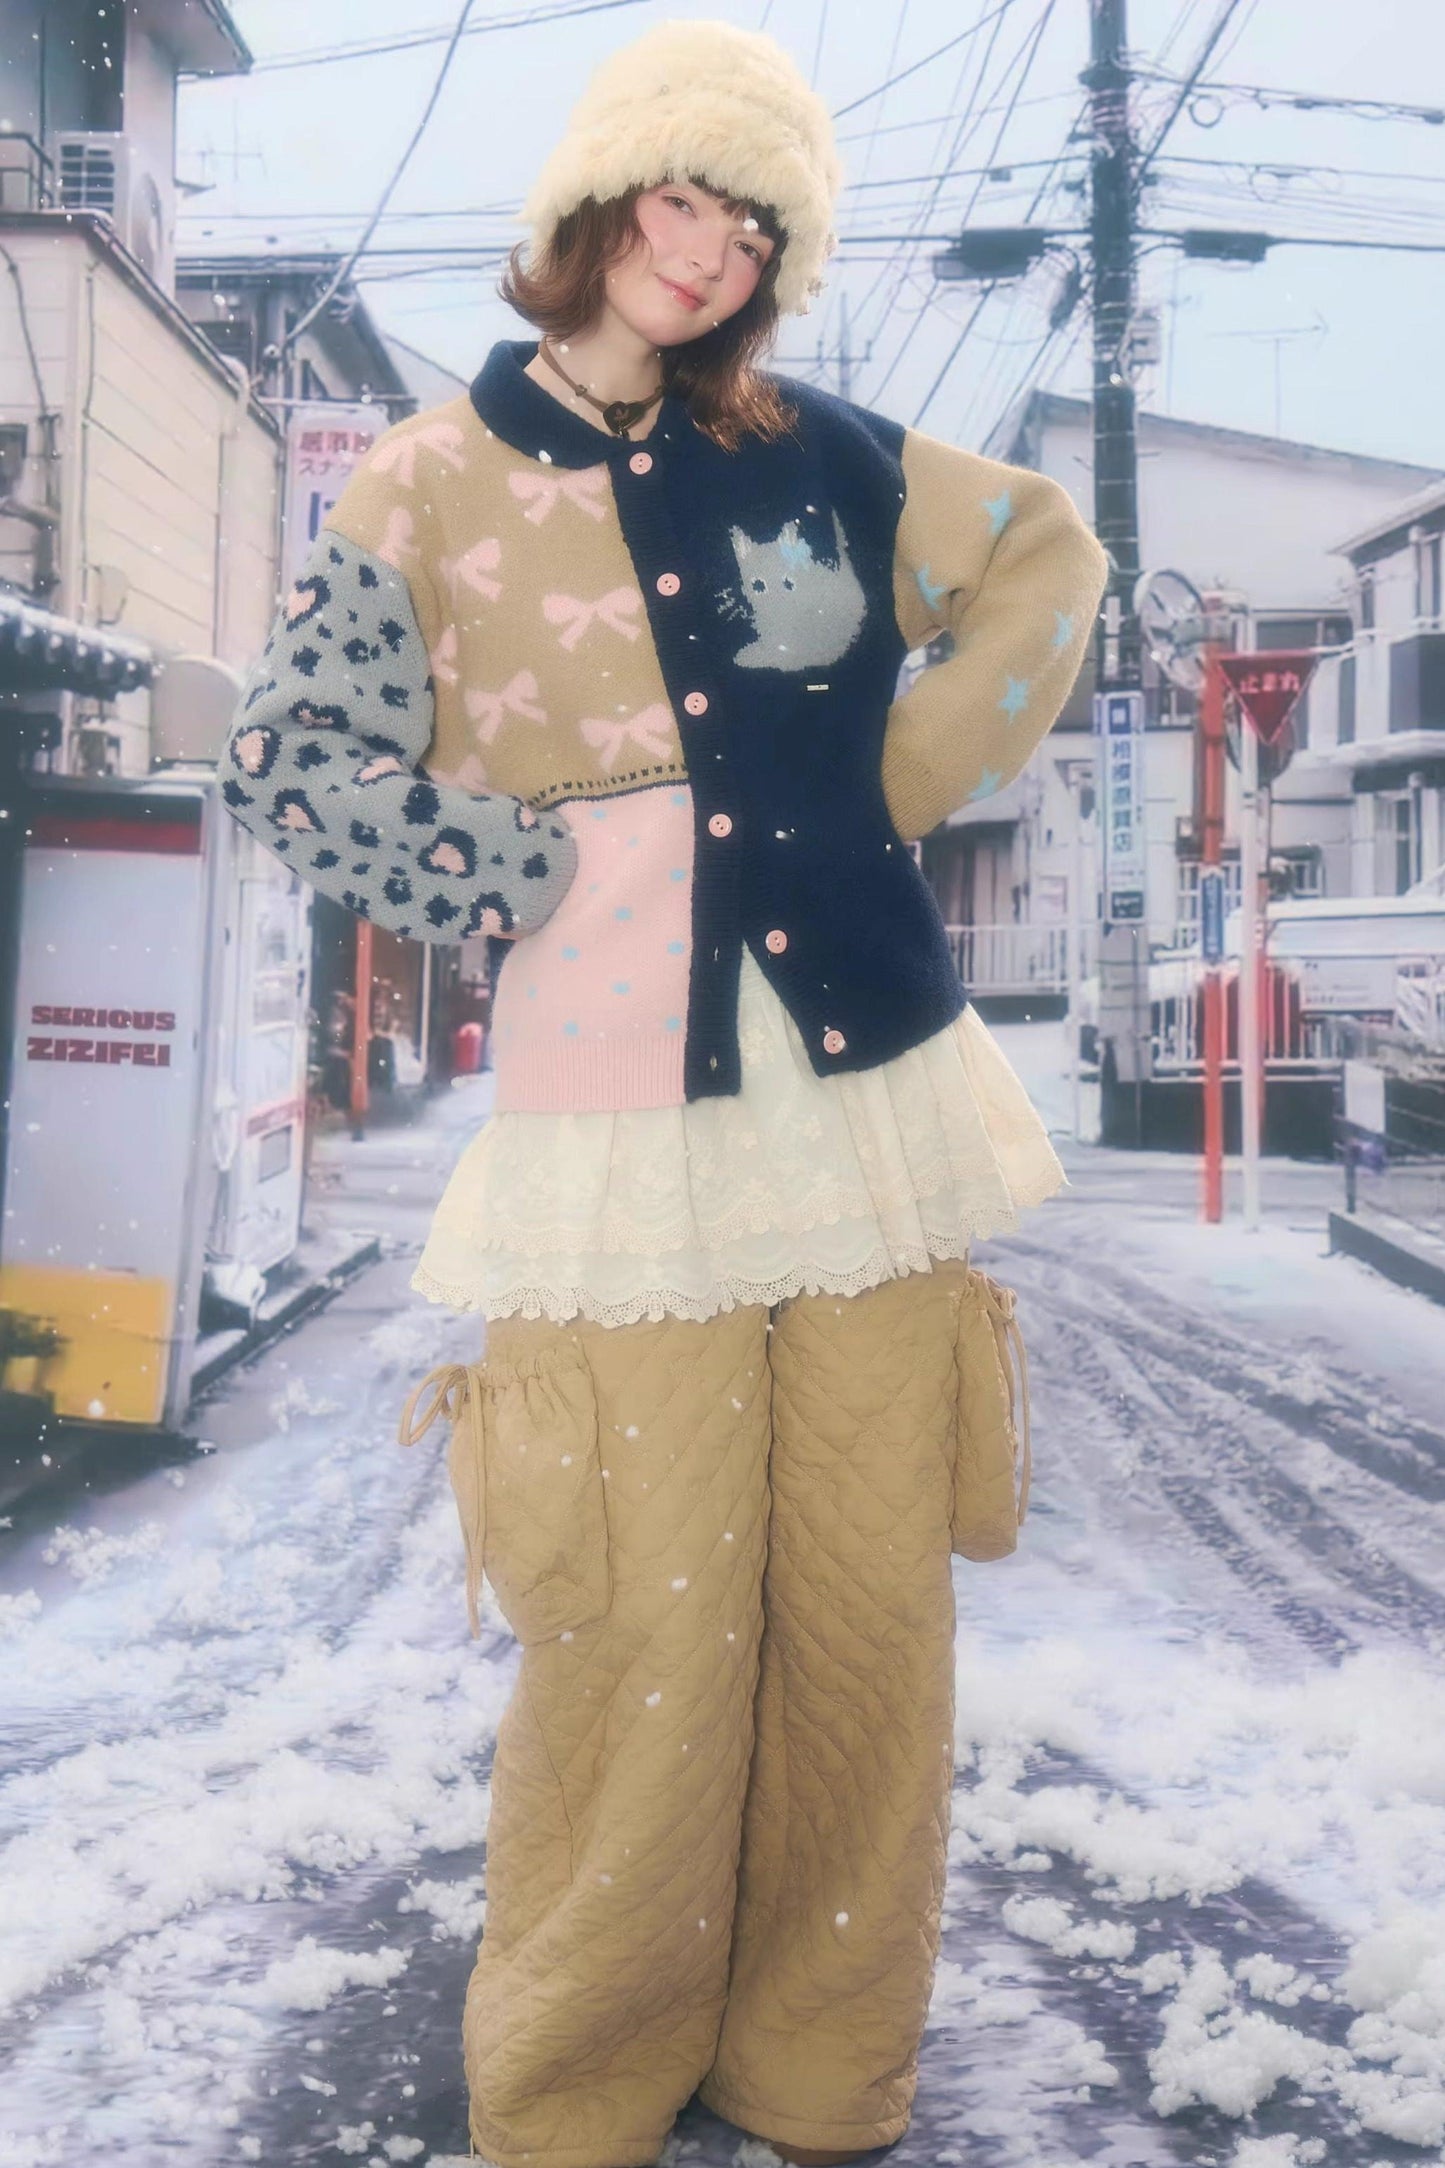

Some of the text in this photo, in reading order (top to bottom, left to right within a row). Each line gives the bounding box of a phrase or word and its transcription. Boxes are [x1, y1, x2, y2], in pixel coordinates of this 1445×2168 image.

[1240, 669, 1300, 694] 止まれ
[31, 1005, 176, 1031] SERIOUS
